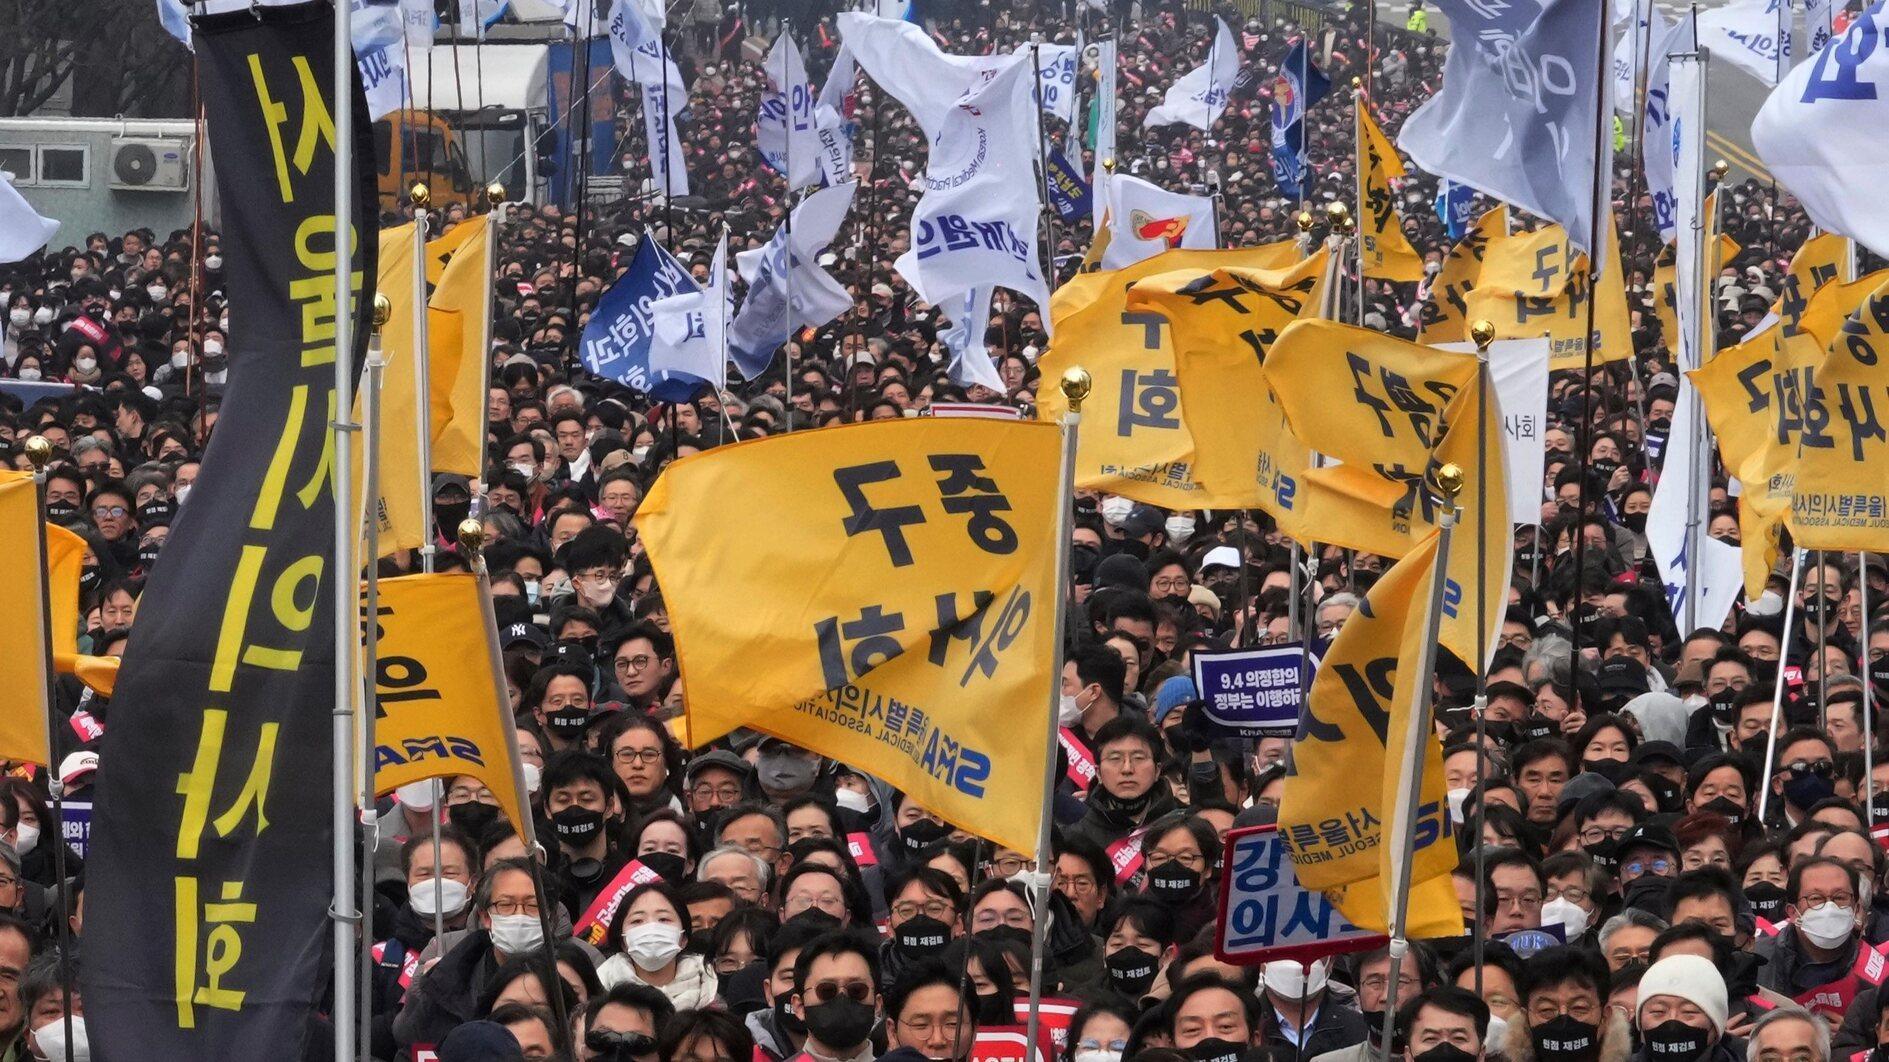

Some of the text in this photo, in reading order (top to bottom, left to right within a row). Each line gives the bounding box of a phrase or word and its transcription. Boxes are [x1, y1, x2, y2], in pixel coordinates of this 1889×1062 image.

[1221, 667, 1299, 690] 9.4 의정합의
[1214, 692, 1254, 711] 정부는
[571, 822, 594, 833] 재검토
[1233, 838, 1302, 893] 강
[1168, 879, 1191, 889] 재검토
[1228, 888, 1376, 947] 의사
[903, 936, 944, 946] 원점 재검토
[1126, 966, 1151, 979] 재검토
[1543, 1037, 1589, 1051] 원점 재검토
[1652, 1041, 1696, 1053] 원점 재검토
